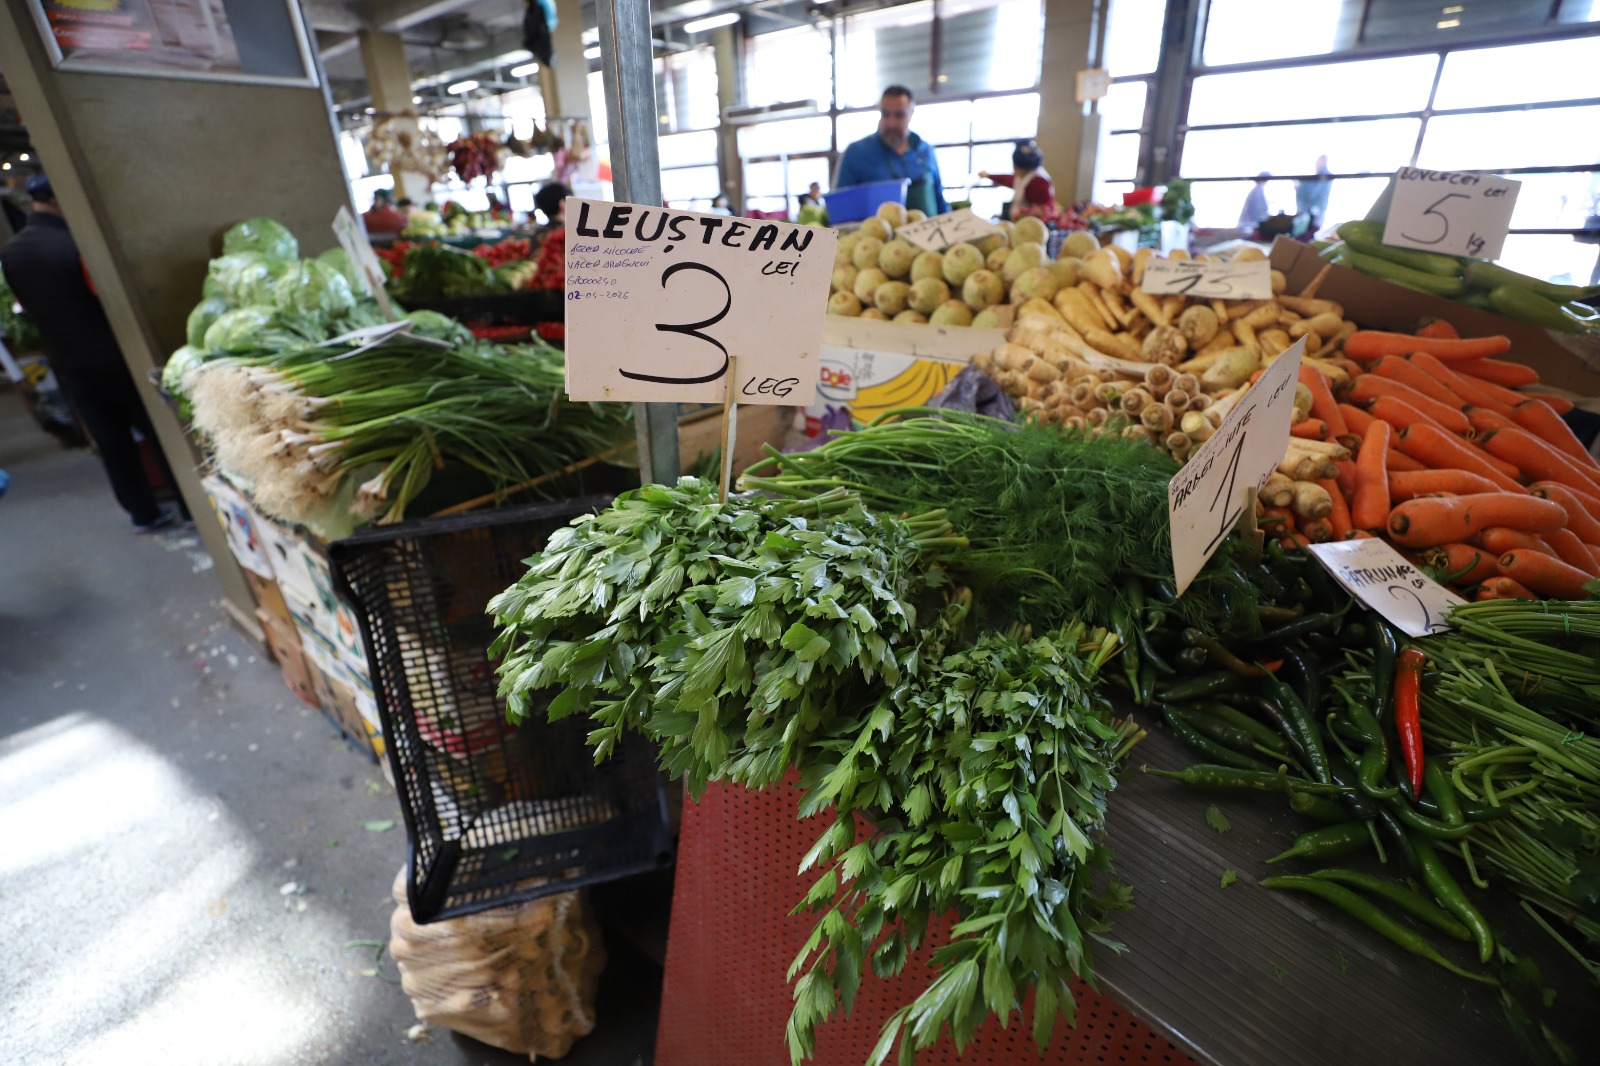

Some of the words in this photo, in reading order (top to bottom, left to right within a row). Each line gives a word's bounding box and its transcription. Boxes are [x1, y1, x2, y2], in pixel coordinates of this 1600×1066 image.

[1401, 193, 1472, 245] 5
[618, 261, 732, 385] 3
[742, 376, 800, 398] LEG
[820, 366, 853, 387] Dole
[1203, 430, 1247, 557] 1
